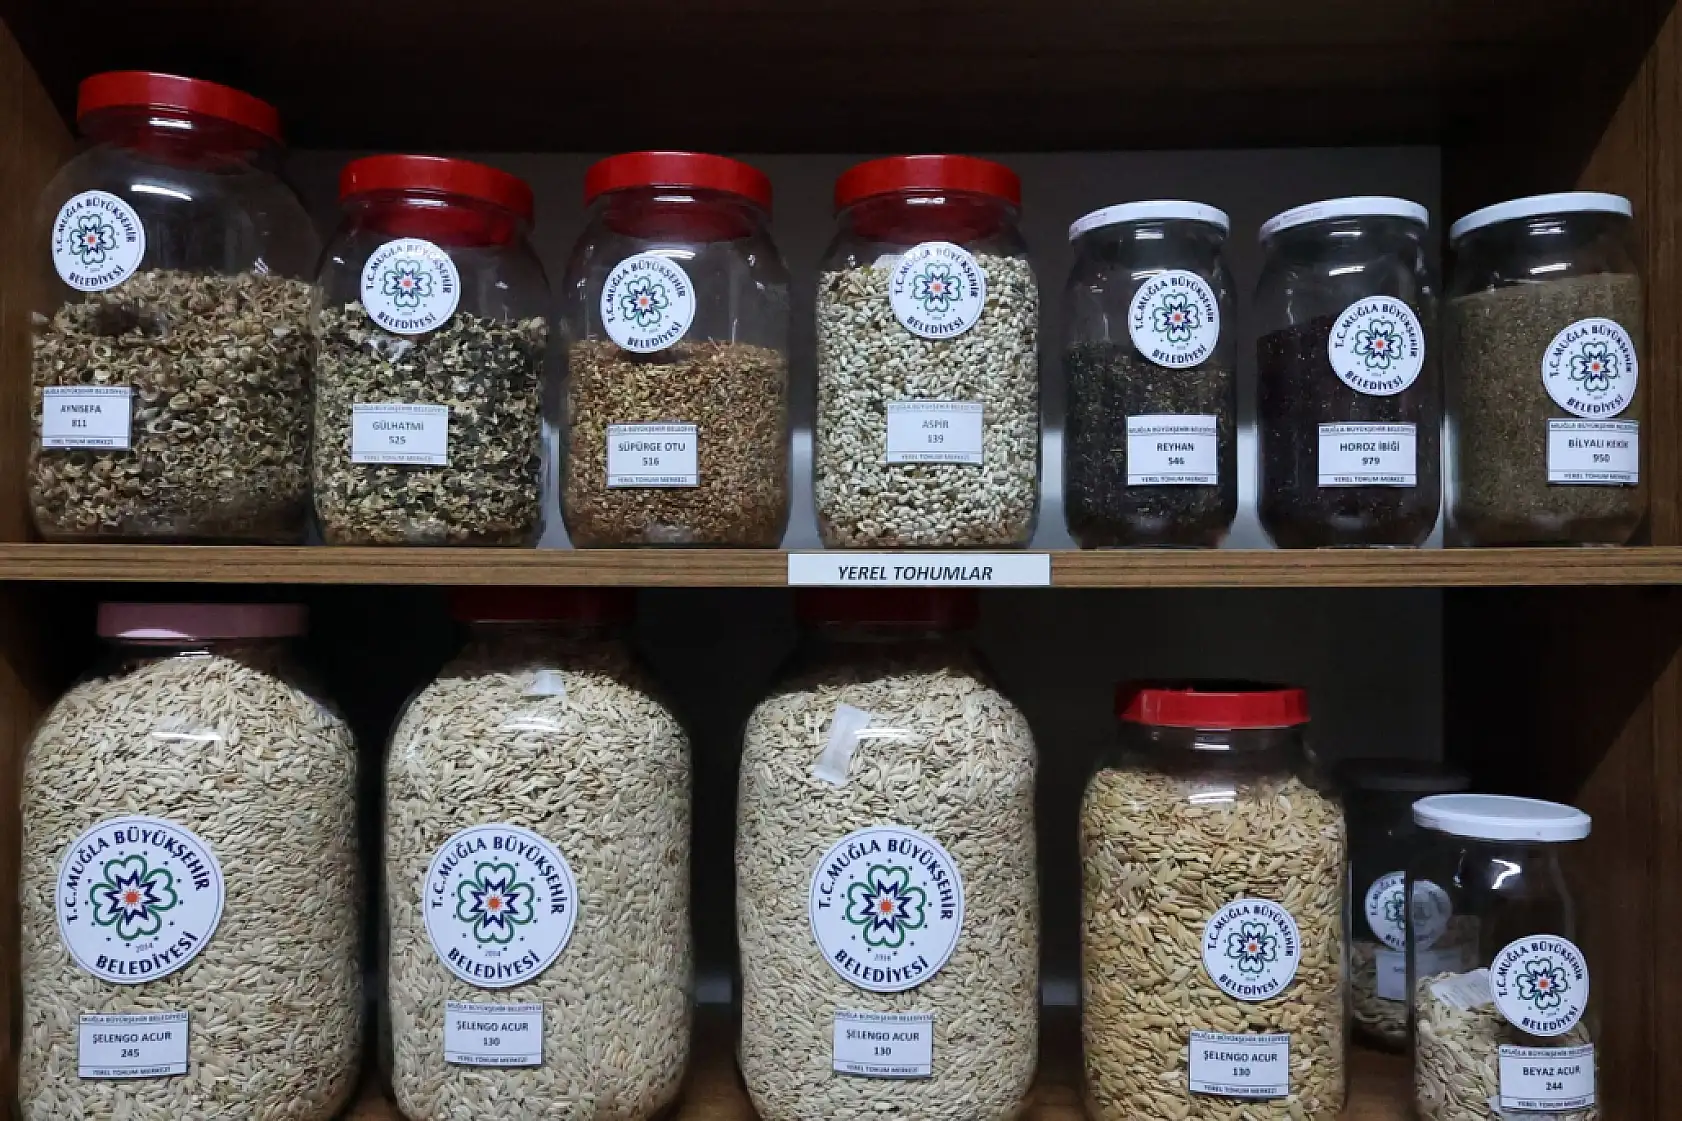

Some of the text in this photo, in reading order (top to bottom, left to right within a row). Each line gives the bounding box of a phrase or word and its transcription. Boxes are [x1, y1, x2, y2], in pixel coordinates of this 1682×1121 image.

[72, 420, 88, 428] 811
[373, 421, 425, 432] GÜLHATMİ
[922, 419, 949, 429] ASPİR
[389, 436, 407, 445] 525
[928, 434, 944, 444] 139
[1569, 438, 1605, 448] BİLYALI
[618, 441, 686, 452] SÜPÜRGE OTU
[1157, 443, 1195, 452] REYHAN
[1340, 442, 1400, 452] HOROZ İBİĞİ
[642, 457, 660, 467] 516
[1362, 457, 1381, 466] 979
[1593, 454, 1611, 463] 950
[838, 566, 993, 581] YEREL TOHUMLAR
[114, 827, 211, 892] BÜYÜKŞEHİR
[493, 836, 568, 916] BÜYÜKŞEHİR
[888, 838, 956, 921] BÜYÜKŞEHİR
[96, 931, 199, 975] BELEDİYESİ
[447, 947, 541, 980] BELEDİYESİ
[835, 949, 930, 983] BELEDİYESİ
[1219, 974, 1279, 996] BELEDİYESİ
[457, 1021, 529, 1032] ŞELENGO ACUR
[92, 1032, 173, 1045] ŞELENGO ACUR
[846, 1029, 920, 1041] ŞELENGO ACUR
[483, 1038, 501, 1047] 130
[121, 1049, 140, 1058] 245
[874, 1047, 892, 1056] 130
[1204, 1050, 1278, 1062] ŞELENGO ACUR
[1233, 1067, 1251, 1077] 130
[1523, 1066, 1582, 1077] BEYAZ ACUR
[1546, 1082, 1564, 1091] 244
